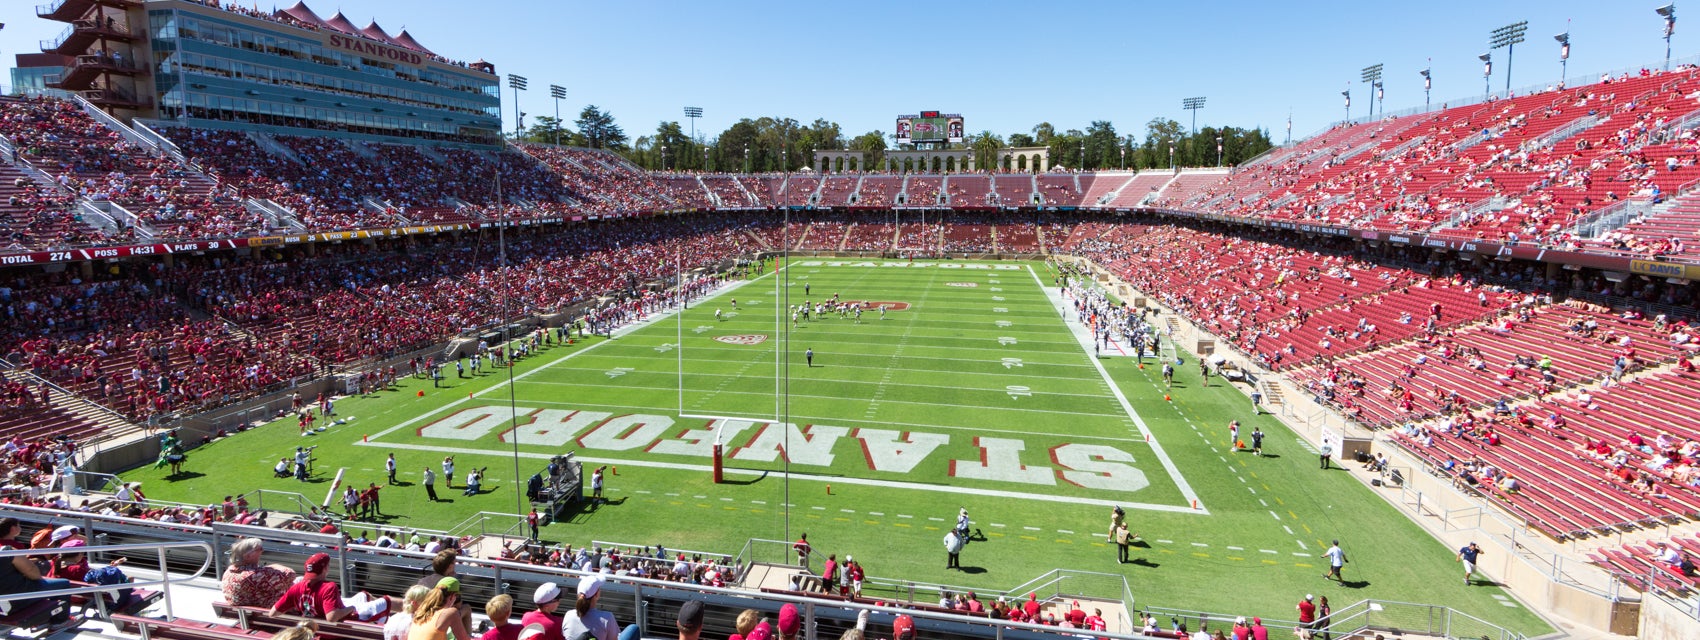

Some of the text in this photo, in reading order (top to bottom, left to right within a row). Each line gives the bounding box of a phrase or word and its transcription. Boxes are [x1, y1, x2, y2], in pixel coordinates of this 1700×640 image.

[330, 34, 422, 65] STANFORD
[1, 241, 220, 264] TOTAL 274 POSS 14:31 PLAYS 30
[1634, 262, 1681, 275] UC DAVIS
[417, 405, 1150, 491] STANFORD
